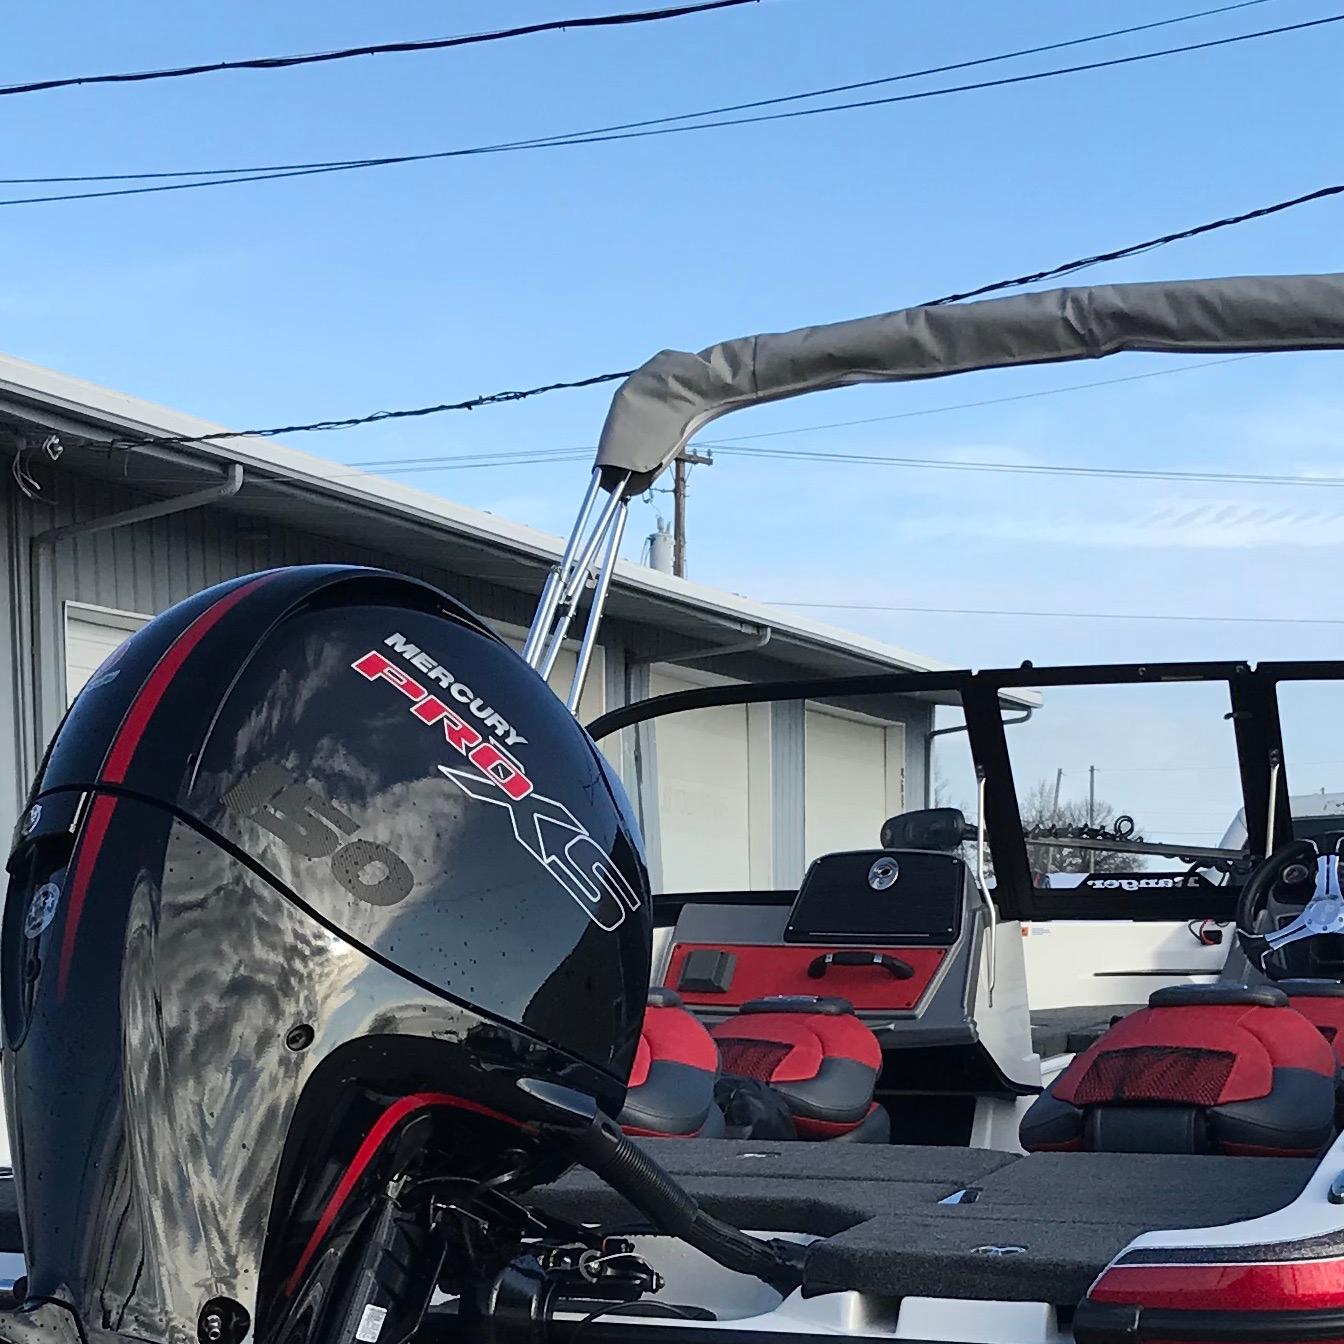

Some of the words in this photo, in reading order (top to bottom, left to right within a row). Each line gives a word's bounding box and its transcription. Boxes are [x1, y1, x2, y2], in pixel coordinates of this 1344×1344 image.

[350, 650, 534, 801] PRO
[384, 632, 529, 747] MERCURY
[437, 735, 642, 932] XS
